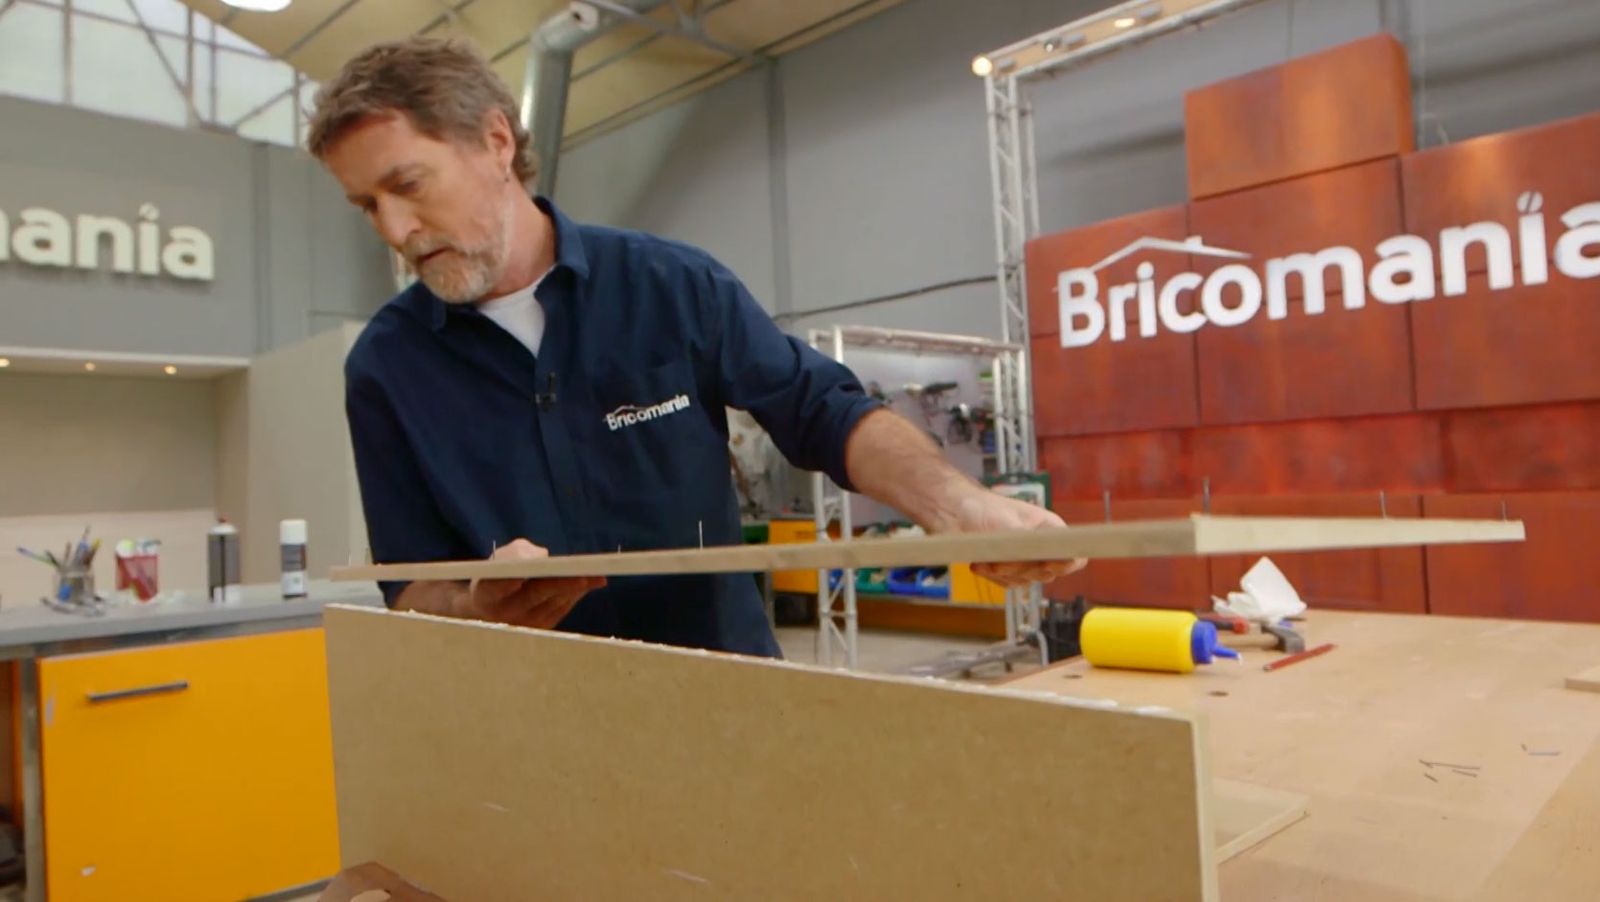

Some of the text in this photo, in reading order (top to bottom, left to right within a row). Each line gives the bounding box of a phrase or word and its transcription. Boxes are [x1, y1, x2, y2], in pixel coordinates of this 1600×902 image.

[0, 202, 215, 280] ania
[1058, 192, 1600, 348] Bricomania
[606, 394, 690, 431] Bricomania
